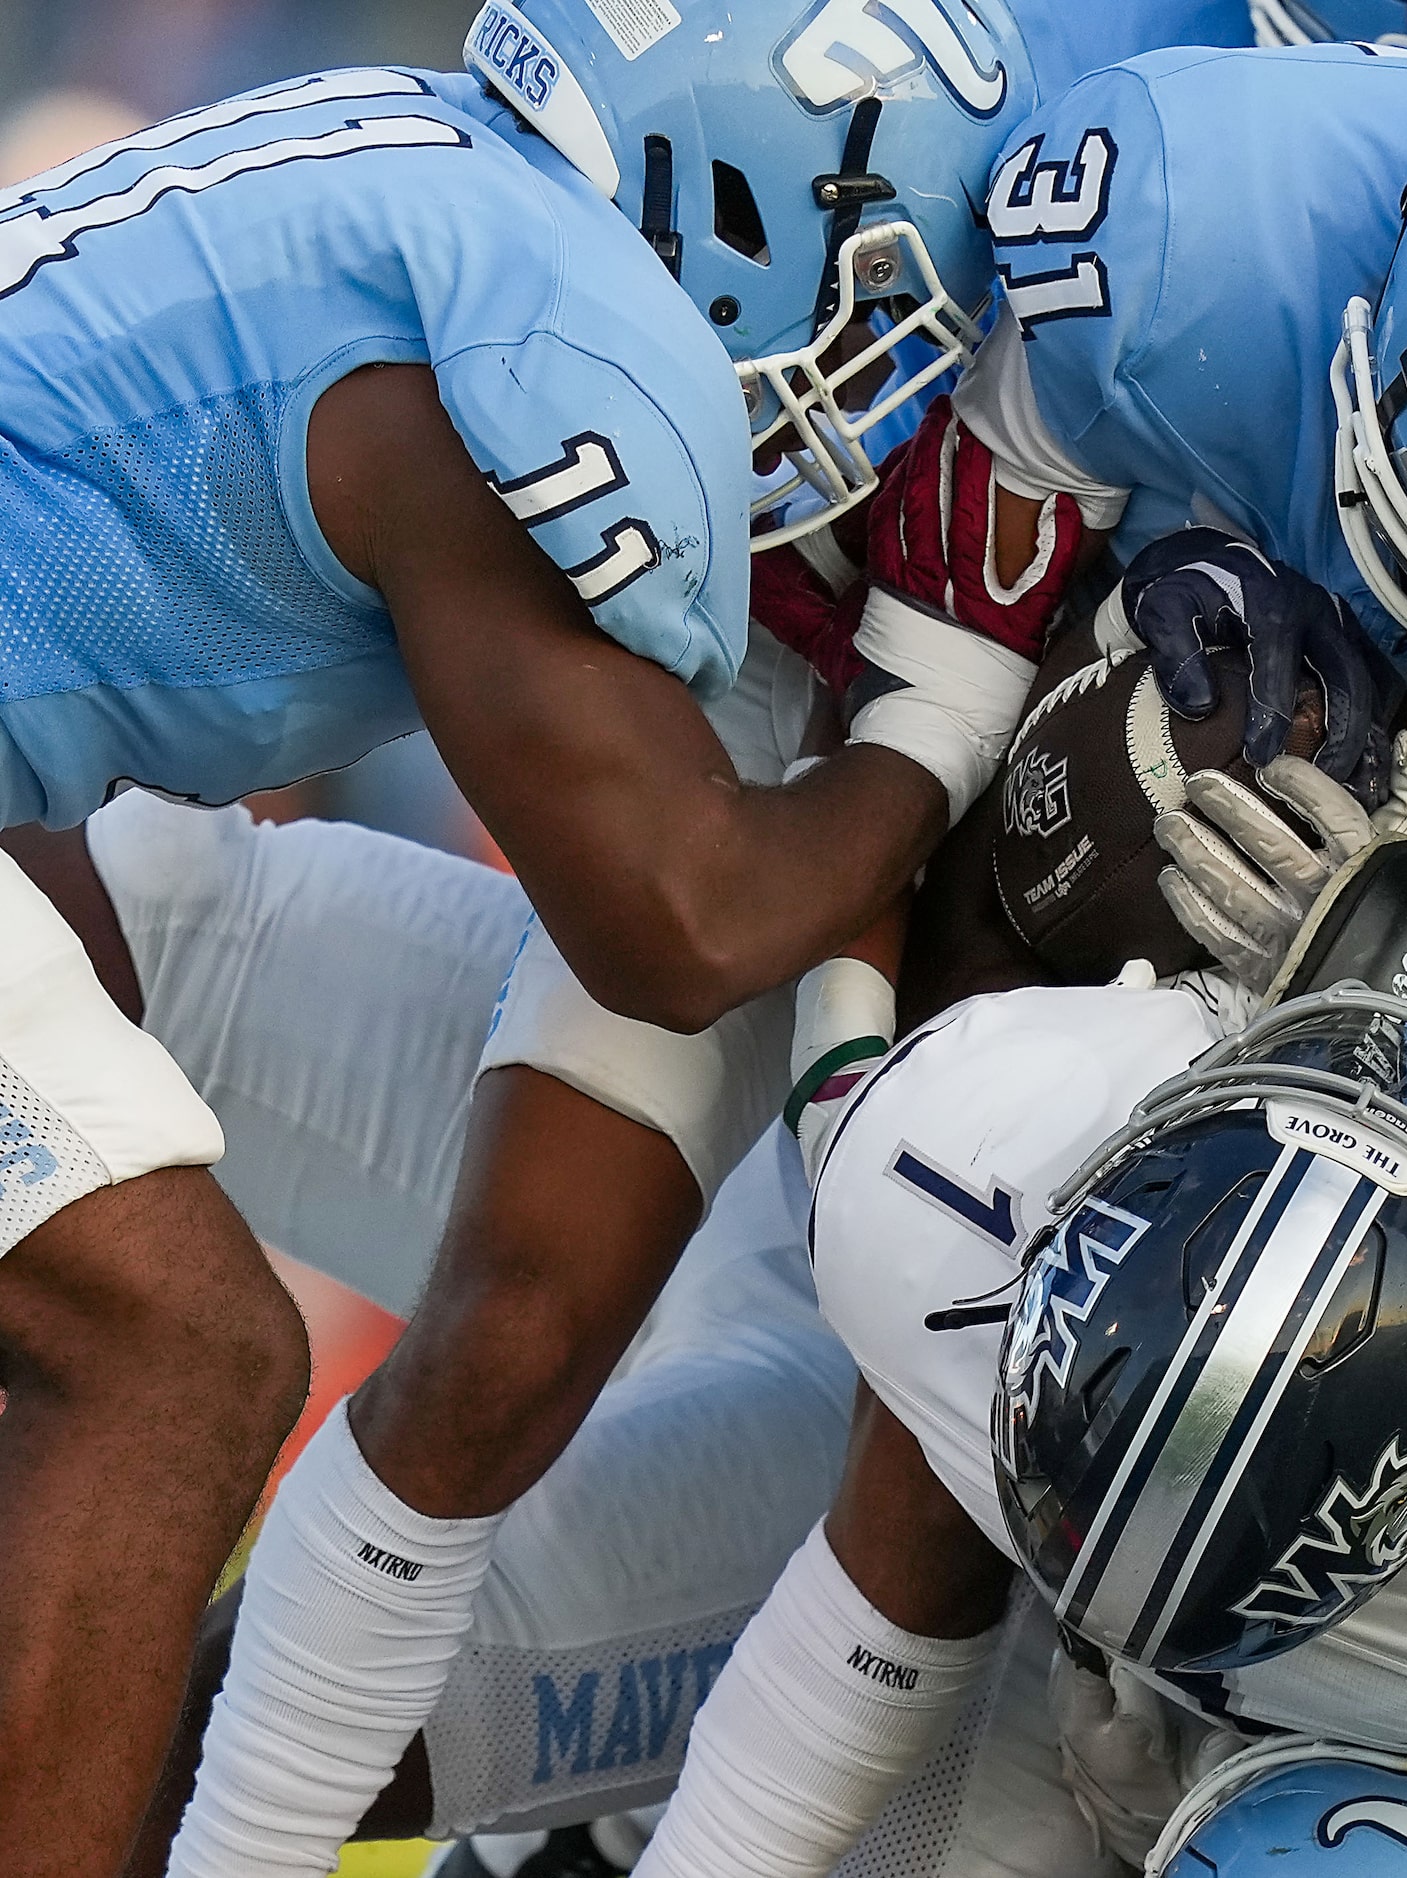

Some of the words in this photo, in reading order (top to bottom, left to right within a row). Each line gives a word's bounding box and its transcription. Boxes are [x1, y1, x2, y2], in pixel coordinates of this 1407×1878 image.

[985, 127, 1119, 342] 31
[481, 430, 663, 608] 11
[1023, 874, 1056, 905] TEAM
[1285, 1116, 1357, 1149] GROVE
[1362, 1144, 1400, 1178] THE
[882, 1138, 1029, 1260] 1
[357, 1542, 424, 1581] NXTRND
[846, 1644, 919, 1690] NXTRND
